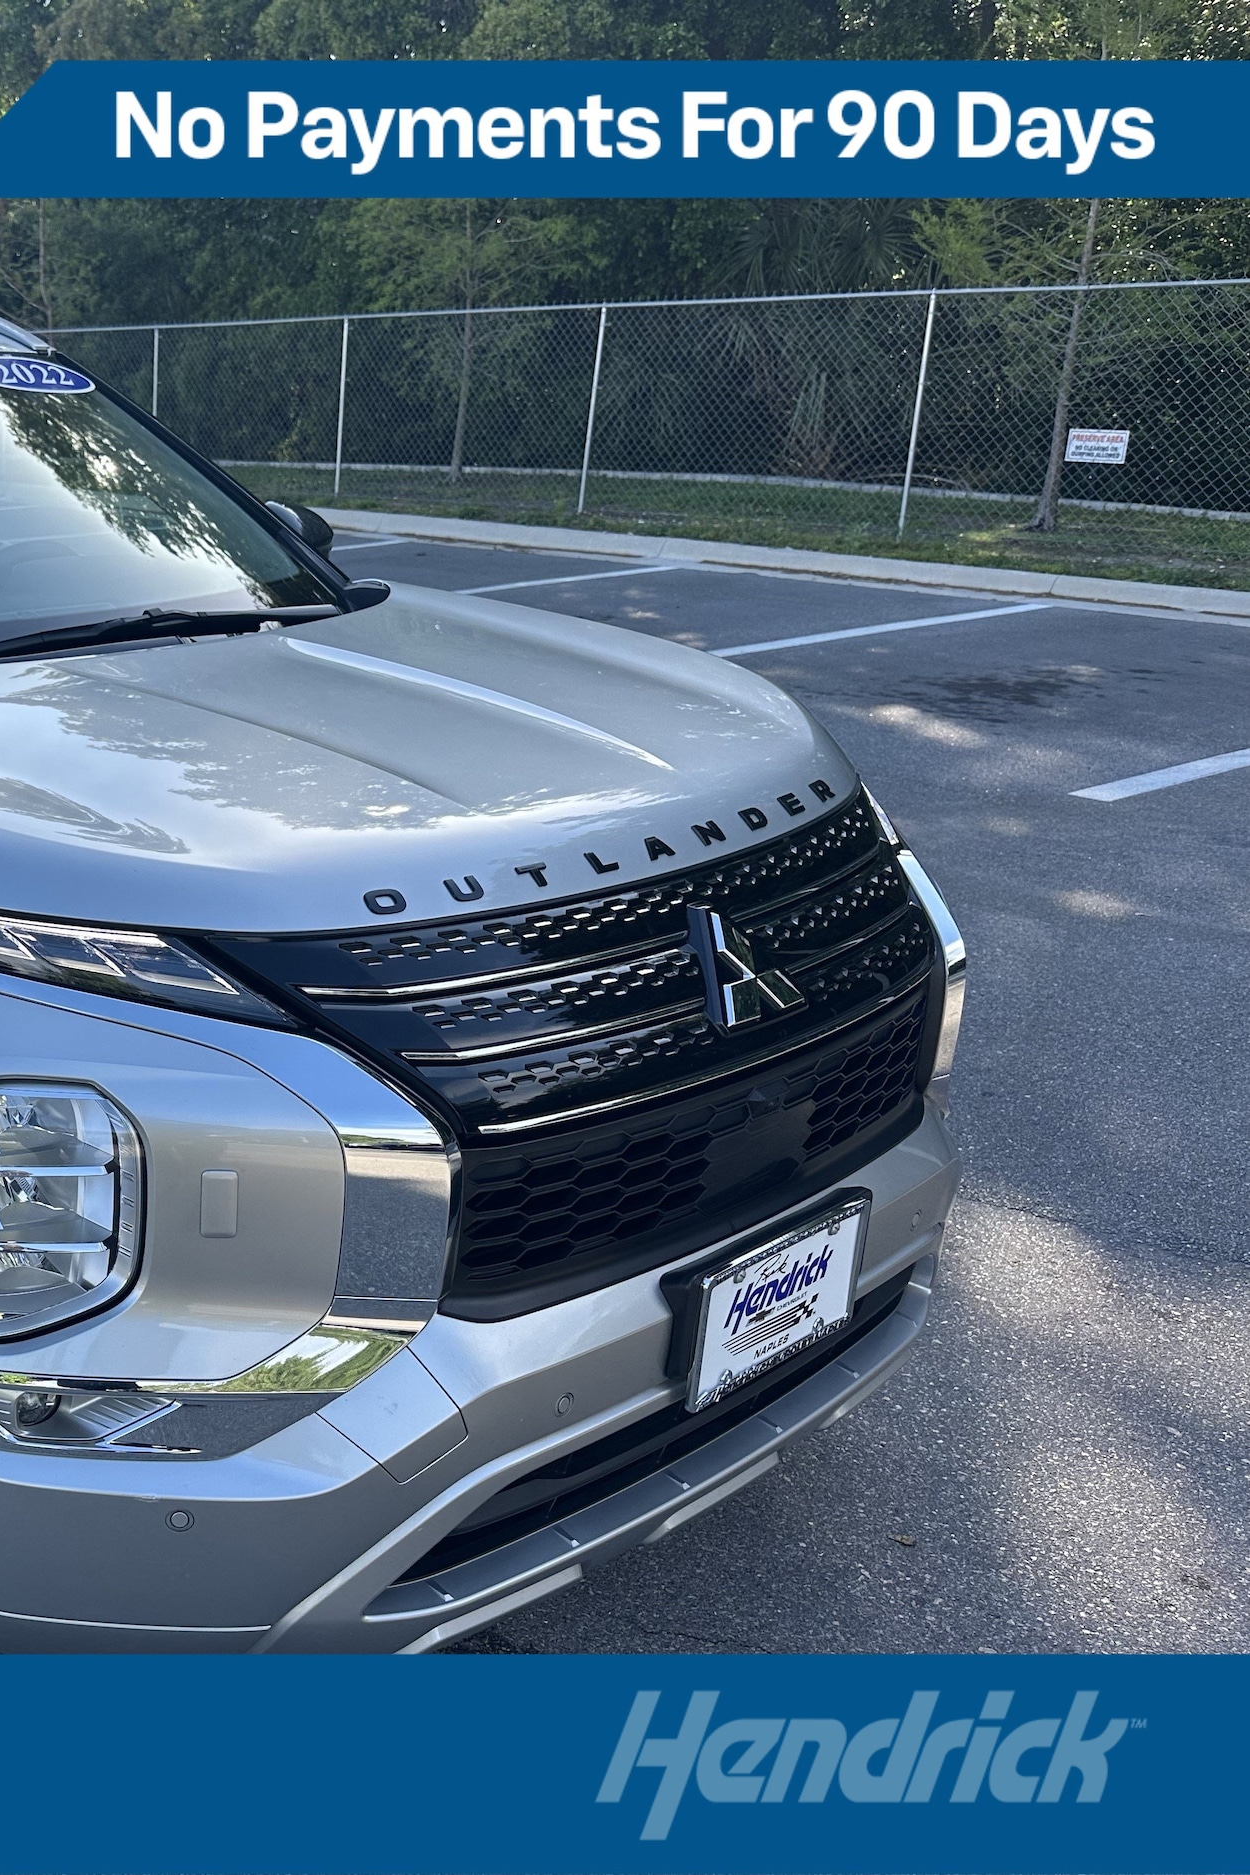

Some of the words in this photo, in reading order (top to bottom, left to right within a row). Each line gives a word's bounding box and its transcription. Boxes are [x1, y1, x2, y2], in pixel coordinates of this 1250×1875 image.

[1072, 433, 1106, 443] PRESERVE
[1106, 435, 1124, 443] AREA
[363, 779, 836, 915] OUTLANDER
[723, 1244, 834, 1336] Hendrick
[776, 1291, 808, 1311] CHEVROLET
[753, 1334, 790, 1360] NAPLES
